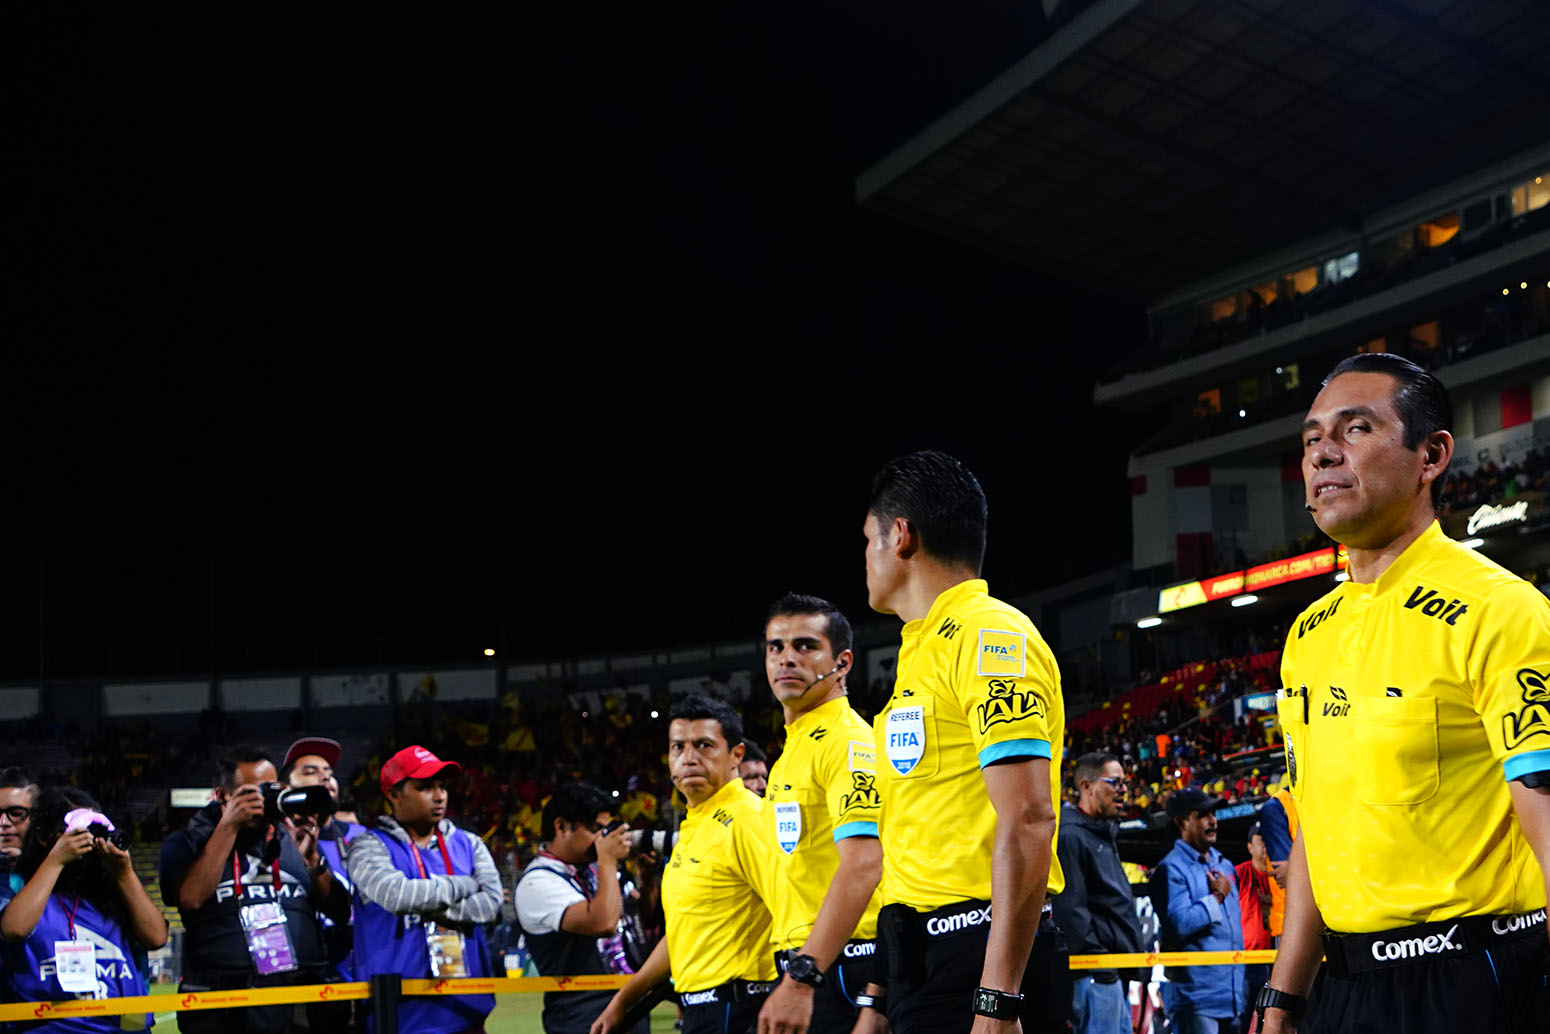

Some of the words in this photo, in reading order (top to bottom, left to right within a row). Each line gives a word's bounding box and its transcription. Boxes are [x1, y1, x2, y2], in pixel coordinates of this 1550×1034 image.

[1404, 586, 1470, 627] Voit
[1298, 596, 1344, 640] Voit
[983, 645, 1008, 654] FIFA
[890, 711, 920, 722] REFEREE
[977, 690, 1045, 735] LALA
[1322, 702, 1351, 718] Voit
[890, 732, 919, 748] FIFA
[839, 789, 882, 817] LAL
[779, 821, 798, 833] FIFA
[216, 884, 309, 904] PRMA
[1372, 924, 1460, 962] Comex
[40, 962, 133, 982] PMA
